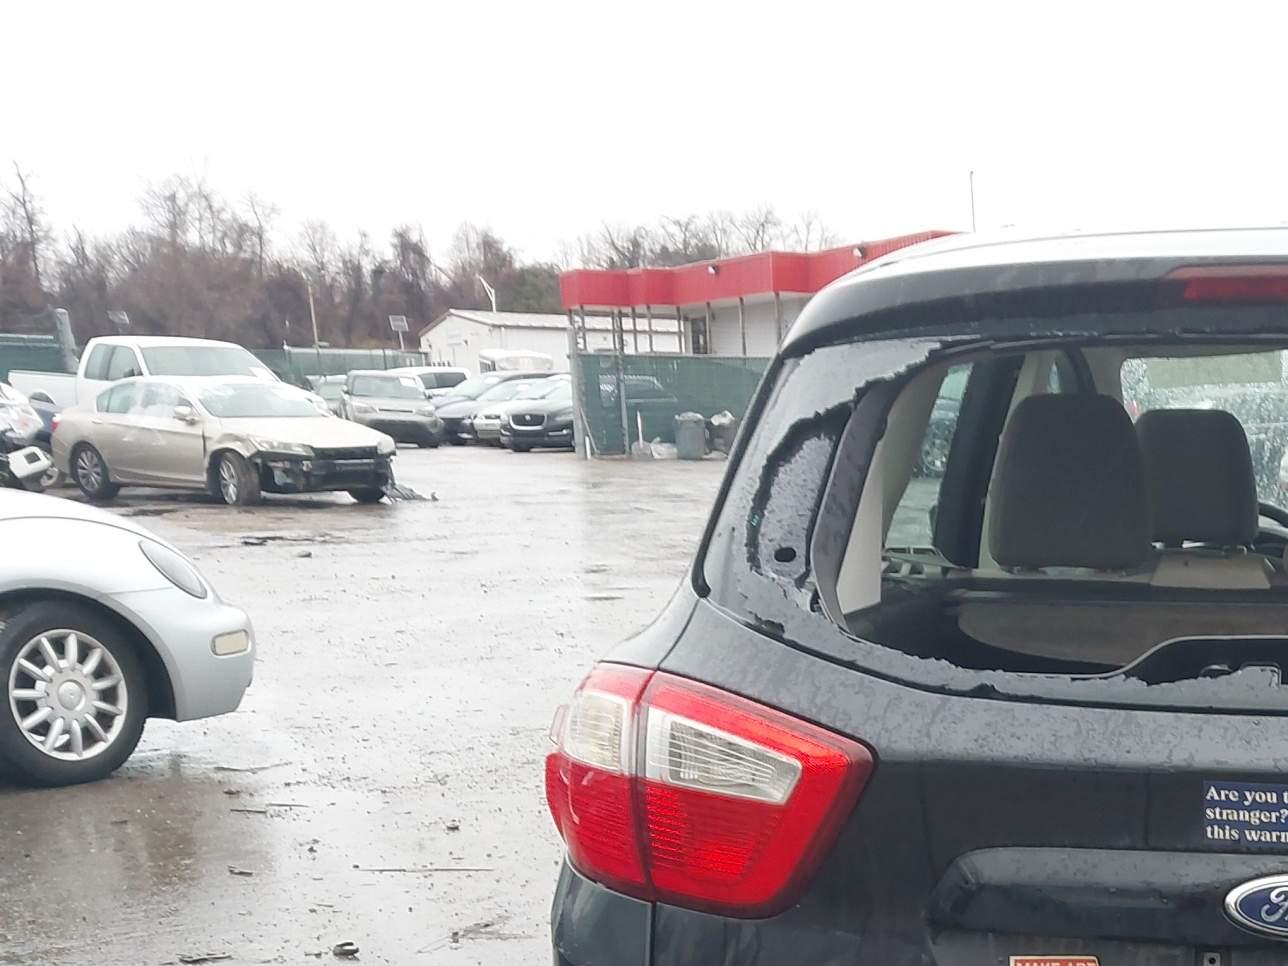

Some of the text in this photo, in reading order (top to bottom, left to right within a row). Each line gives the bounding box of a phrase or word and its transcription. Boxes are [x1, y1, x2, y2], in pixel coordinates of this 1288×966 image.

[1206, 786, 1239, 801] Are
[1243, 790, 1277, 805] you
[1206, 807, 1288, 824] stranger?
[1206, 826, 1239, 840] this
